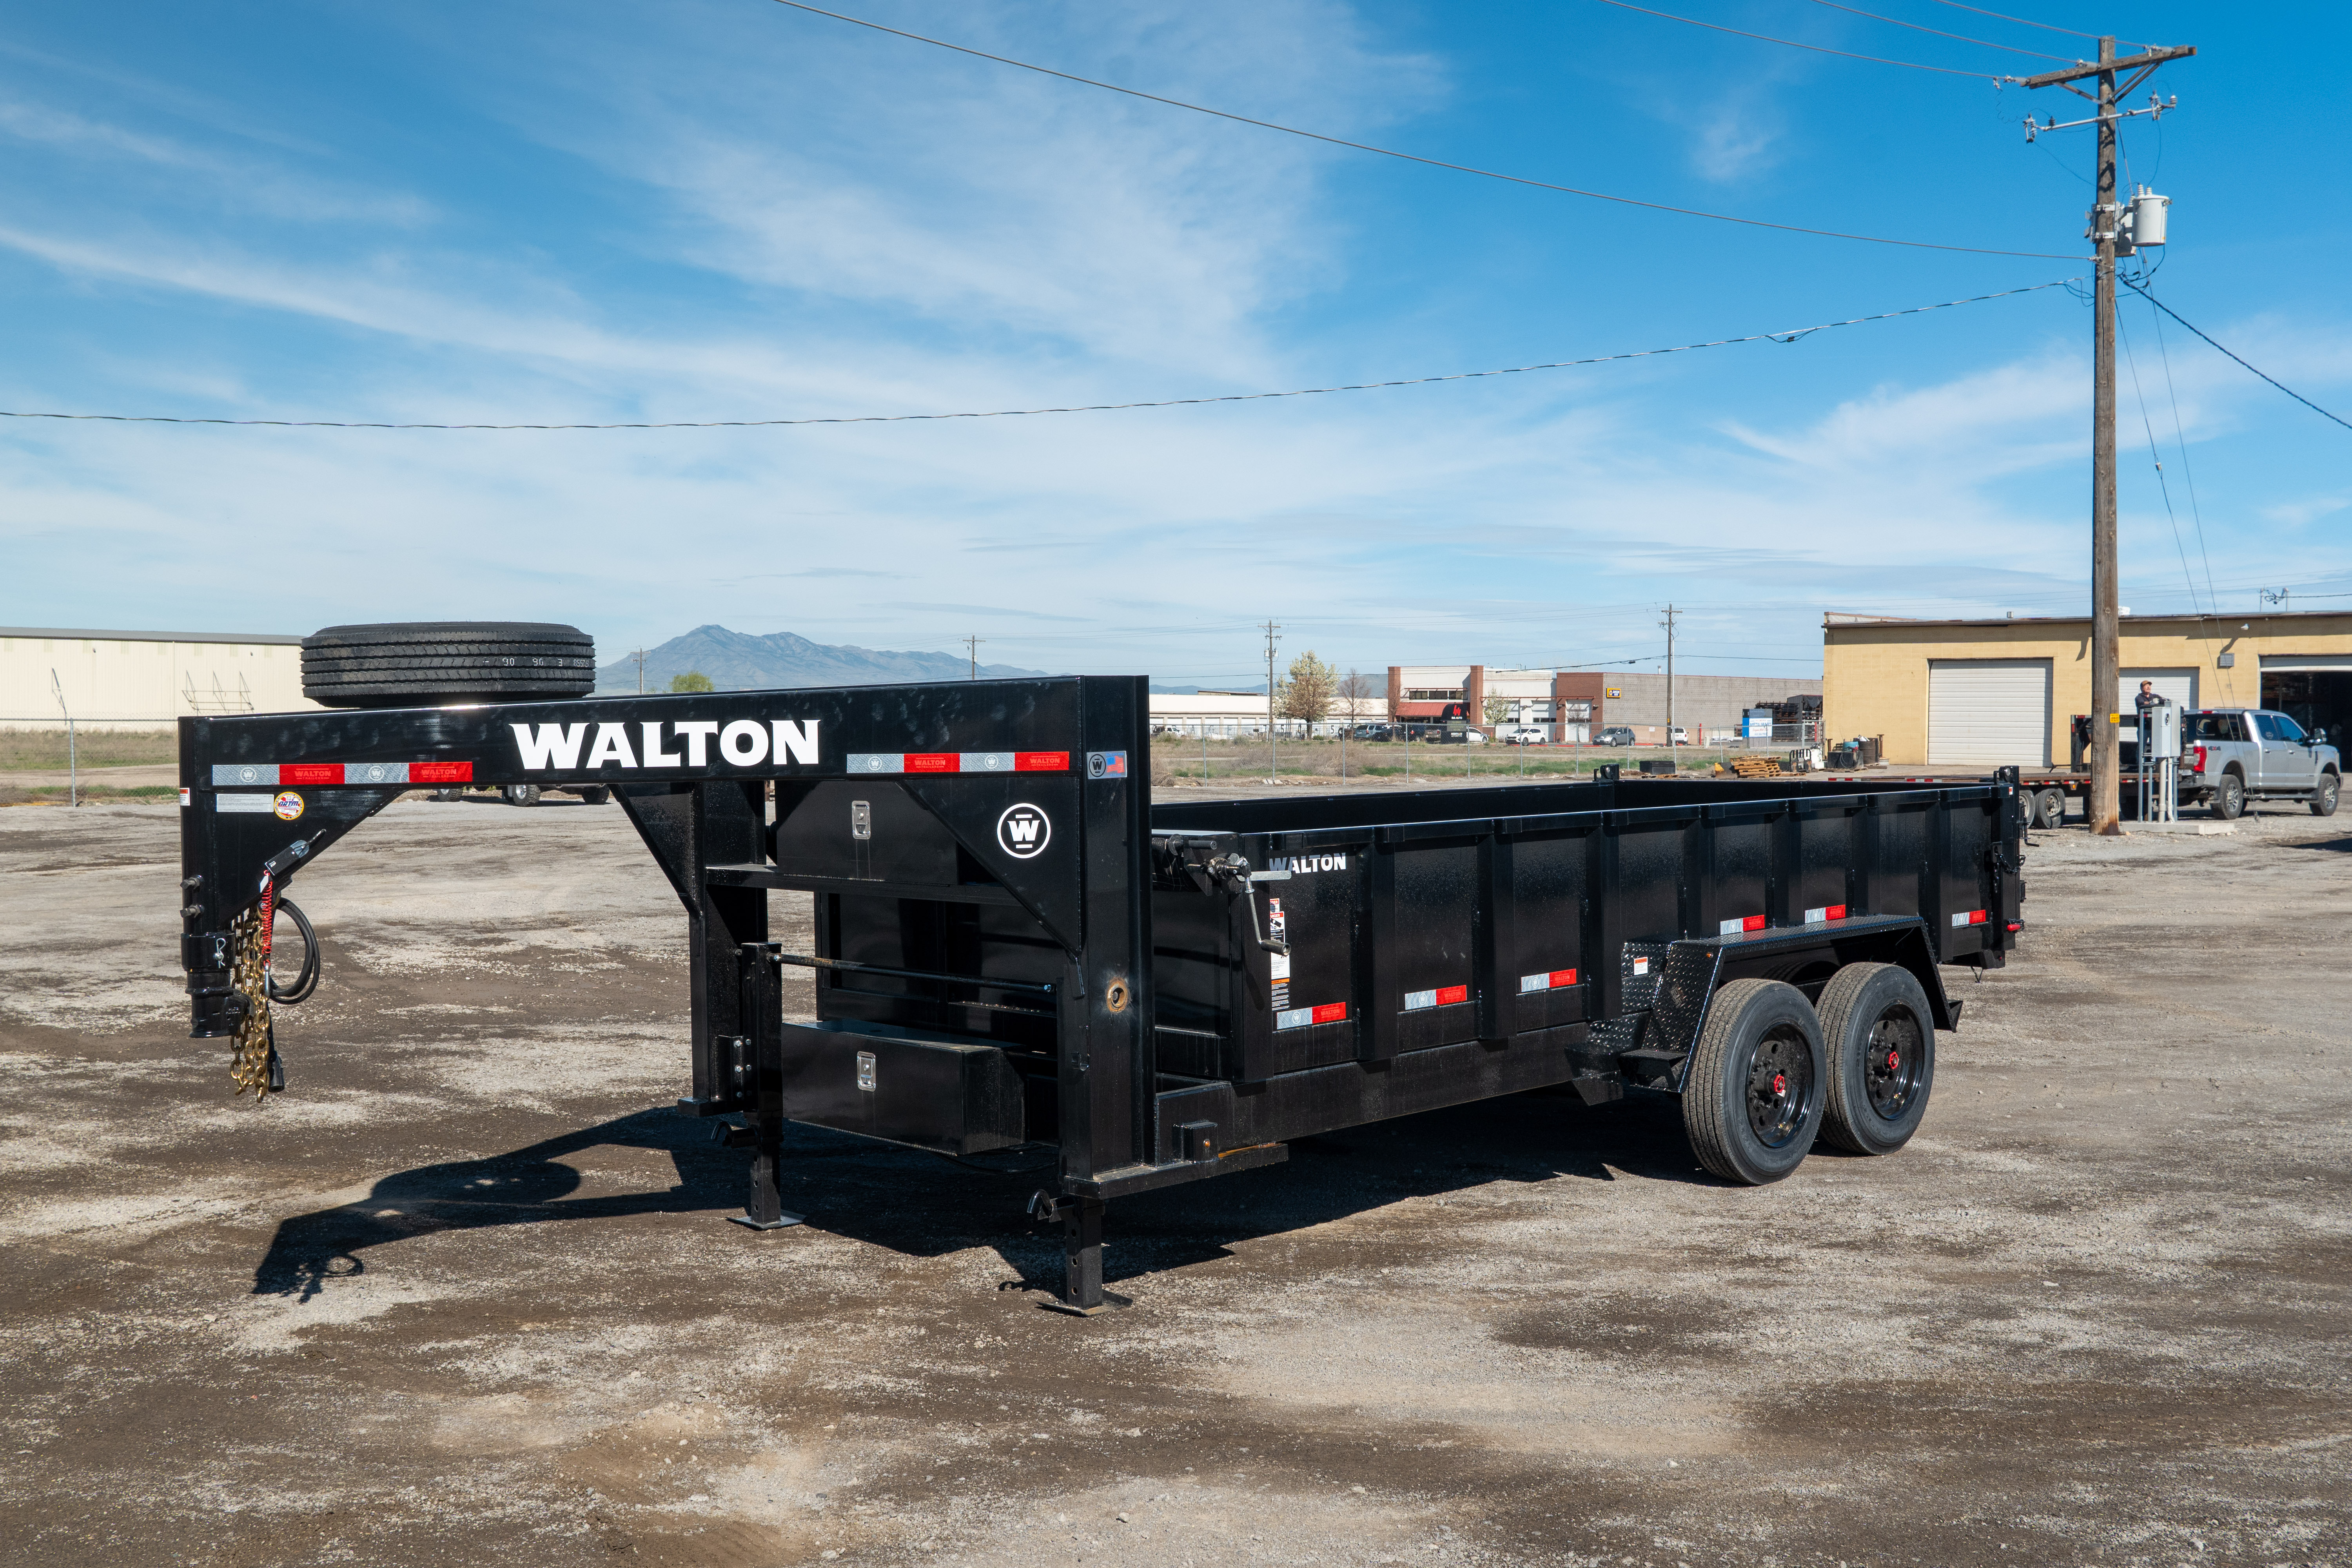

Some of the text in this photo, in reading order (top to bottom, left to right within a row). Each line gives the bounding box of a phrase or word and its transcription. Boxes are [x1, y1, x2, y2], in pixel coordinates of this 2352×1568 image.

[509, 720, 821, 769] WALTON
[1007, 820, 1040, 842] W
[1269, 852, 1346, 874] WALTON
